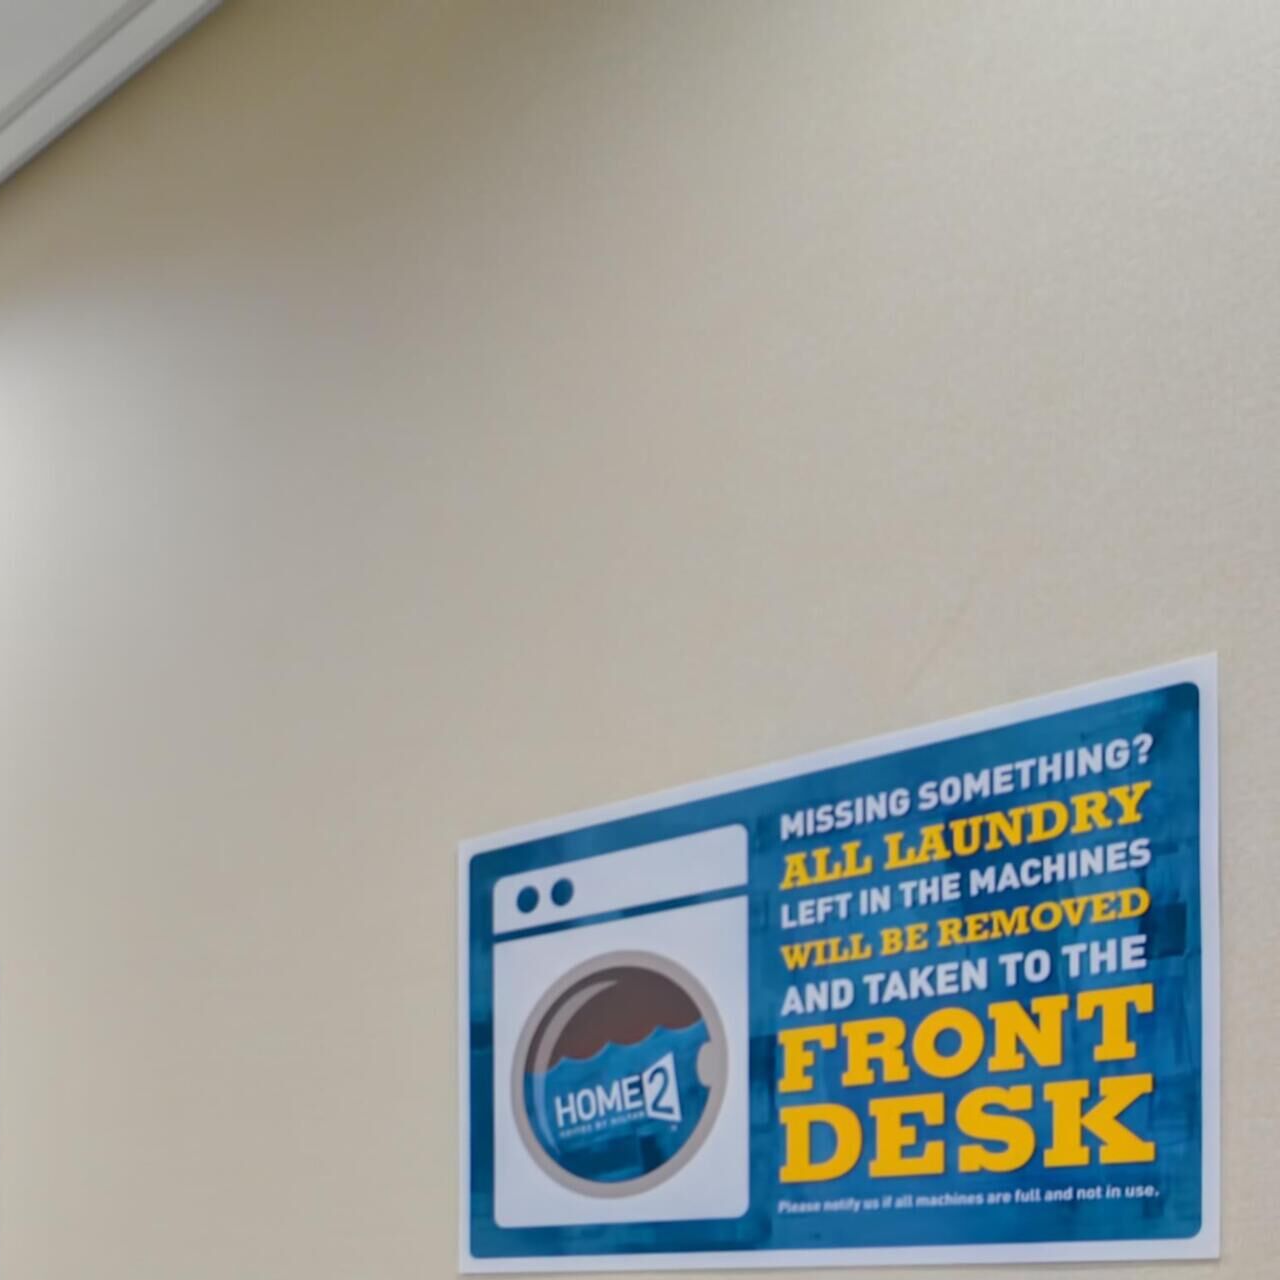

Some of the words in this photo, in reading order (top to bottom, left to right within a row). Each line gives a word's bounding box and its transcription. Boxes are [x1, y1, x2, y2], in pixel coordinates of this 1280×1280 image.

[779, 841, 873, 890] ALL
[883, 781, 1152, 871] LAUNDRY
[780, 788, 910, 841] MISSING
[917, 733, 1154, 810] SOMETHING?
[780, 933, 872, 970] WILL
[881, 923, 929, 955] BE
[938, 887, 1151, 947] REMOVED
[781, 892, 852, 929] LEFT
[860, 886, 890, 914] IN
[899, 872, 961, 908] THE
[969, 837, 1152, 896] MACHINES
[781, 978, 854, 1016] AND
[864, 958, 988, 1004] TAKEN
[999, 949, 1051, 986] TO
[1061, 934, 1148, 978] THE
[777, 982, 1154, 1093] FRONT
[778, 1073, 1155, 1184] DESK
[778, 1199, 821, 1214] Please
[823, 1197, 861, 1213] notify
[863, 1197, 880, 1210] us
[882, 1195, 893, 1209] if
[895, 1194, 914, 1208] all
[915, 1192, 984, 1208] machines
[987, 1191, 1012, 1205] are
[1015, 1187, 1041, 1203] full
[1044, 1186, 1073, 1202] and
[1076, 1185, 1103, 1200] not
[1105, 1184, 1122, 1199] in
[1124, 1184, 1160, 1198] use.
